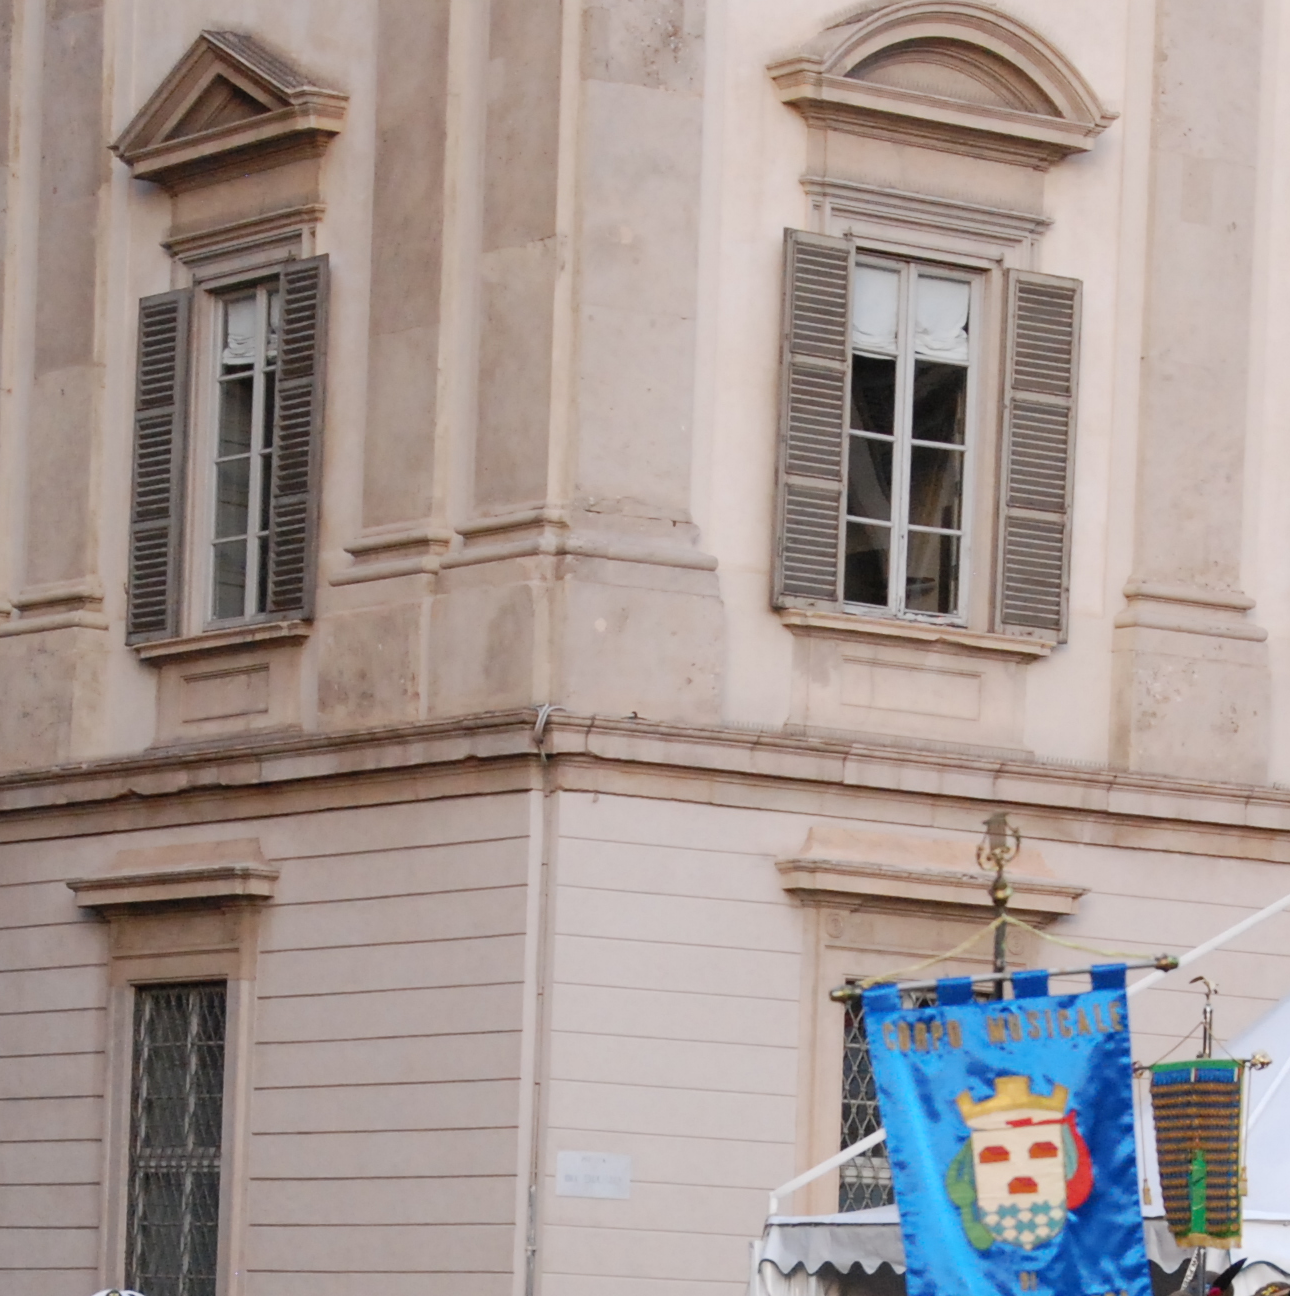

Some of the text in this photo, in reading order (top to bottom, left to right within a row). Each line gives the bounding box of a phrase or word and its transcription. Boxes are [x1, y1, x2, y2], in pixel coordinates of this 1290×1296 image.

[882, 1001, 1124, 1051] CORPO MUSICALE
[1019, 1271, 1037, 1291] DI
